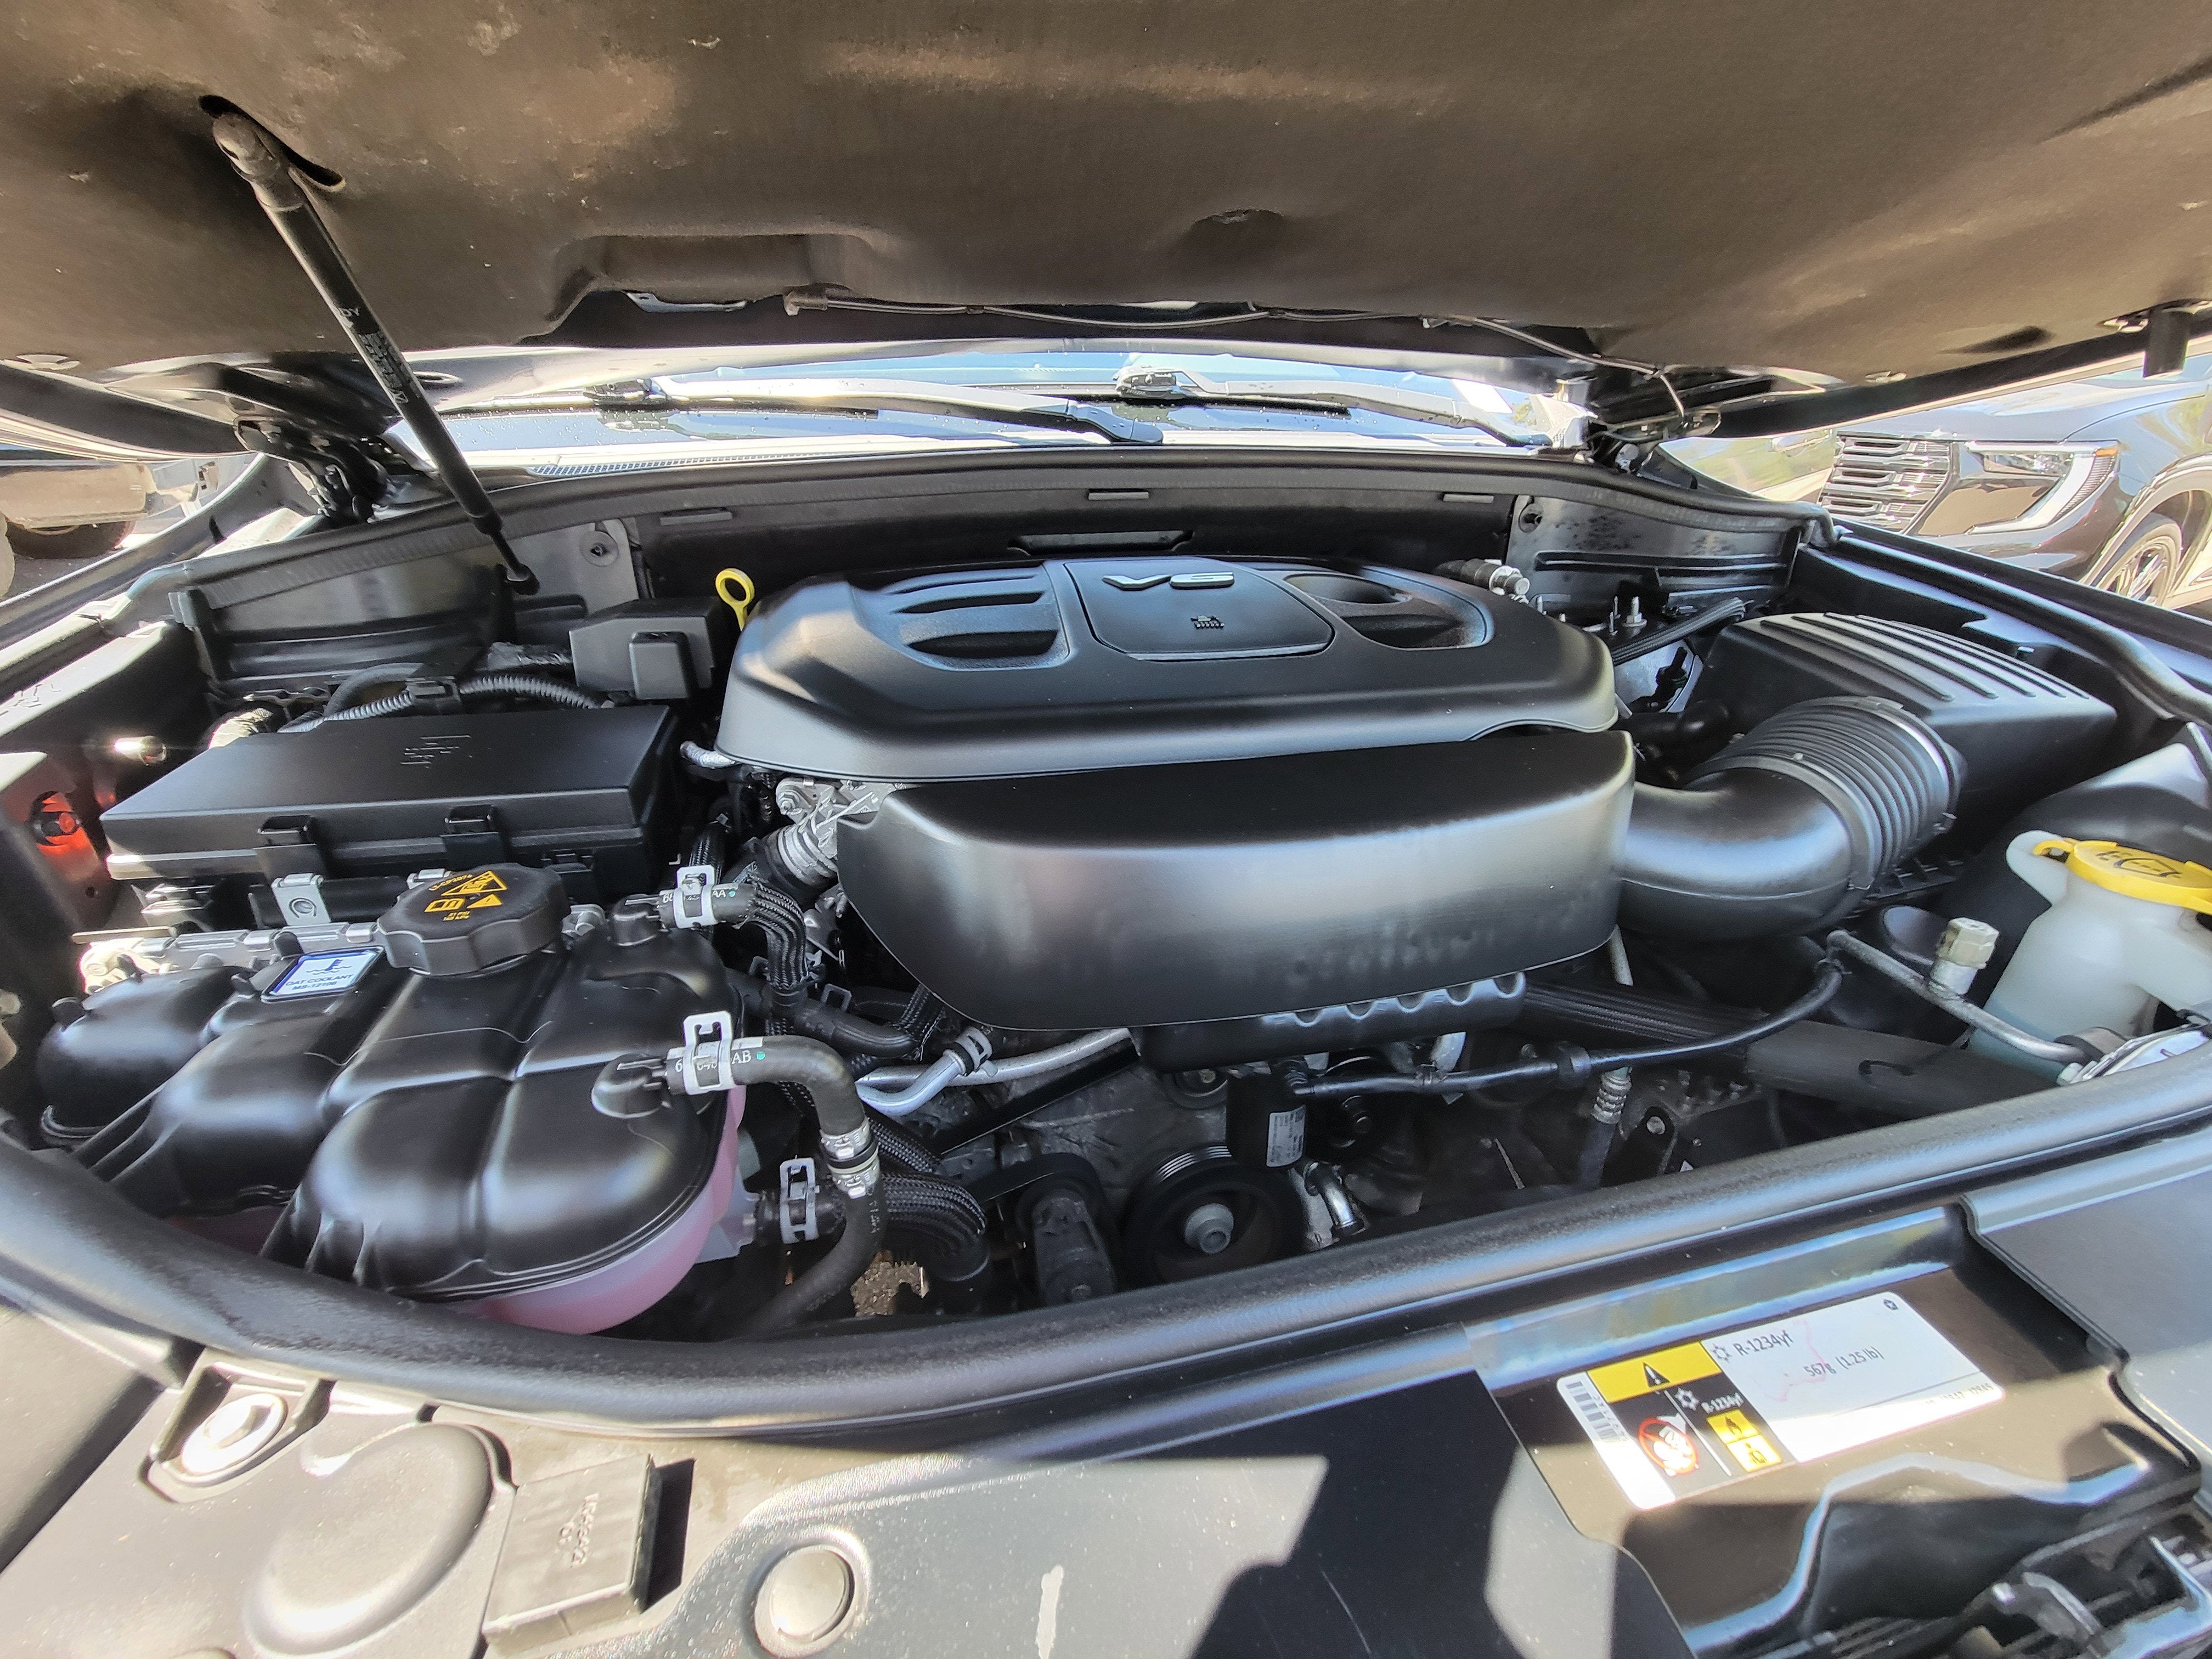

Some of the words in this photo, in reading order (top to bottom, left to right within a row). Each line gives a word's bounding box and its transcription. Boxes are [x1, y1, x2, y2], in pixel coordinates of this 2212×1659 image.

[1101, 572, 1235, 591] V6
[286, 978, 307, 986] OAT
[307, 974, 354, 983] COOLANT
[1733, 1329, 1795, 1356] R-1234yf
[1803, 1362, 1837, 1377] 567g
